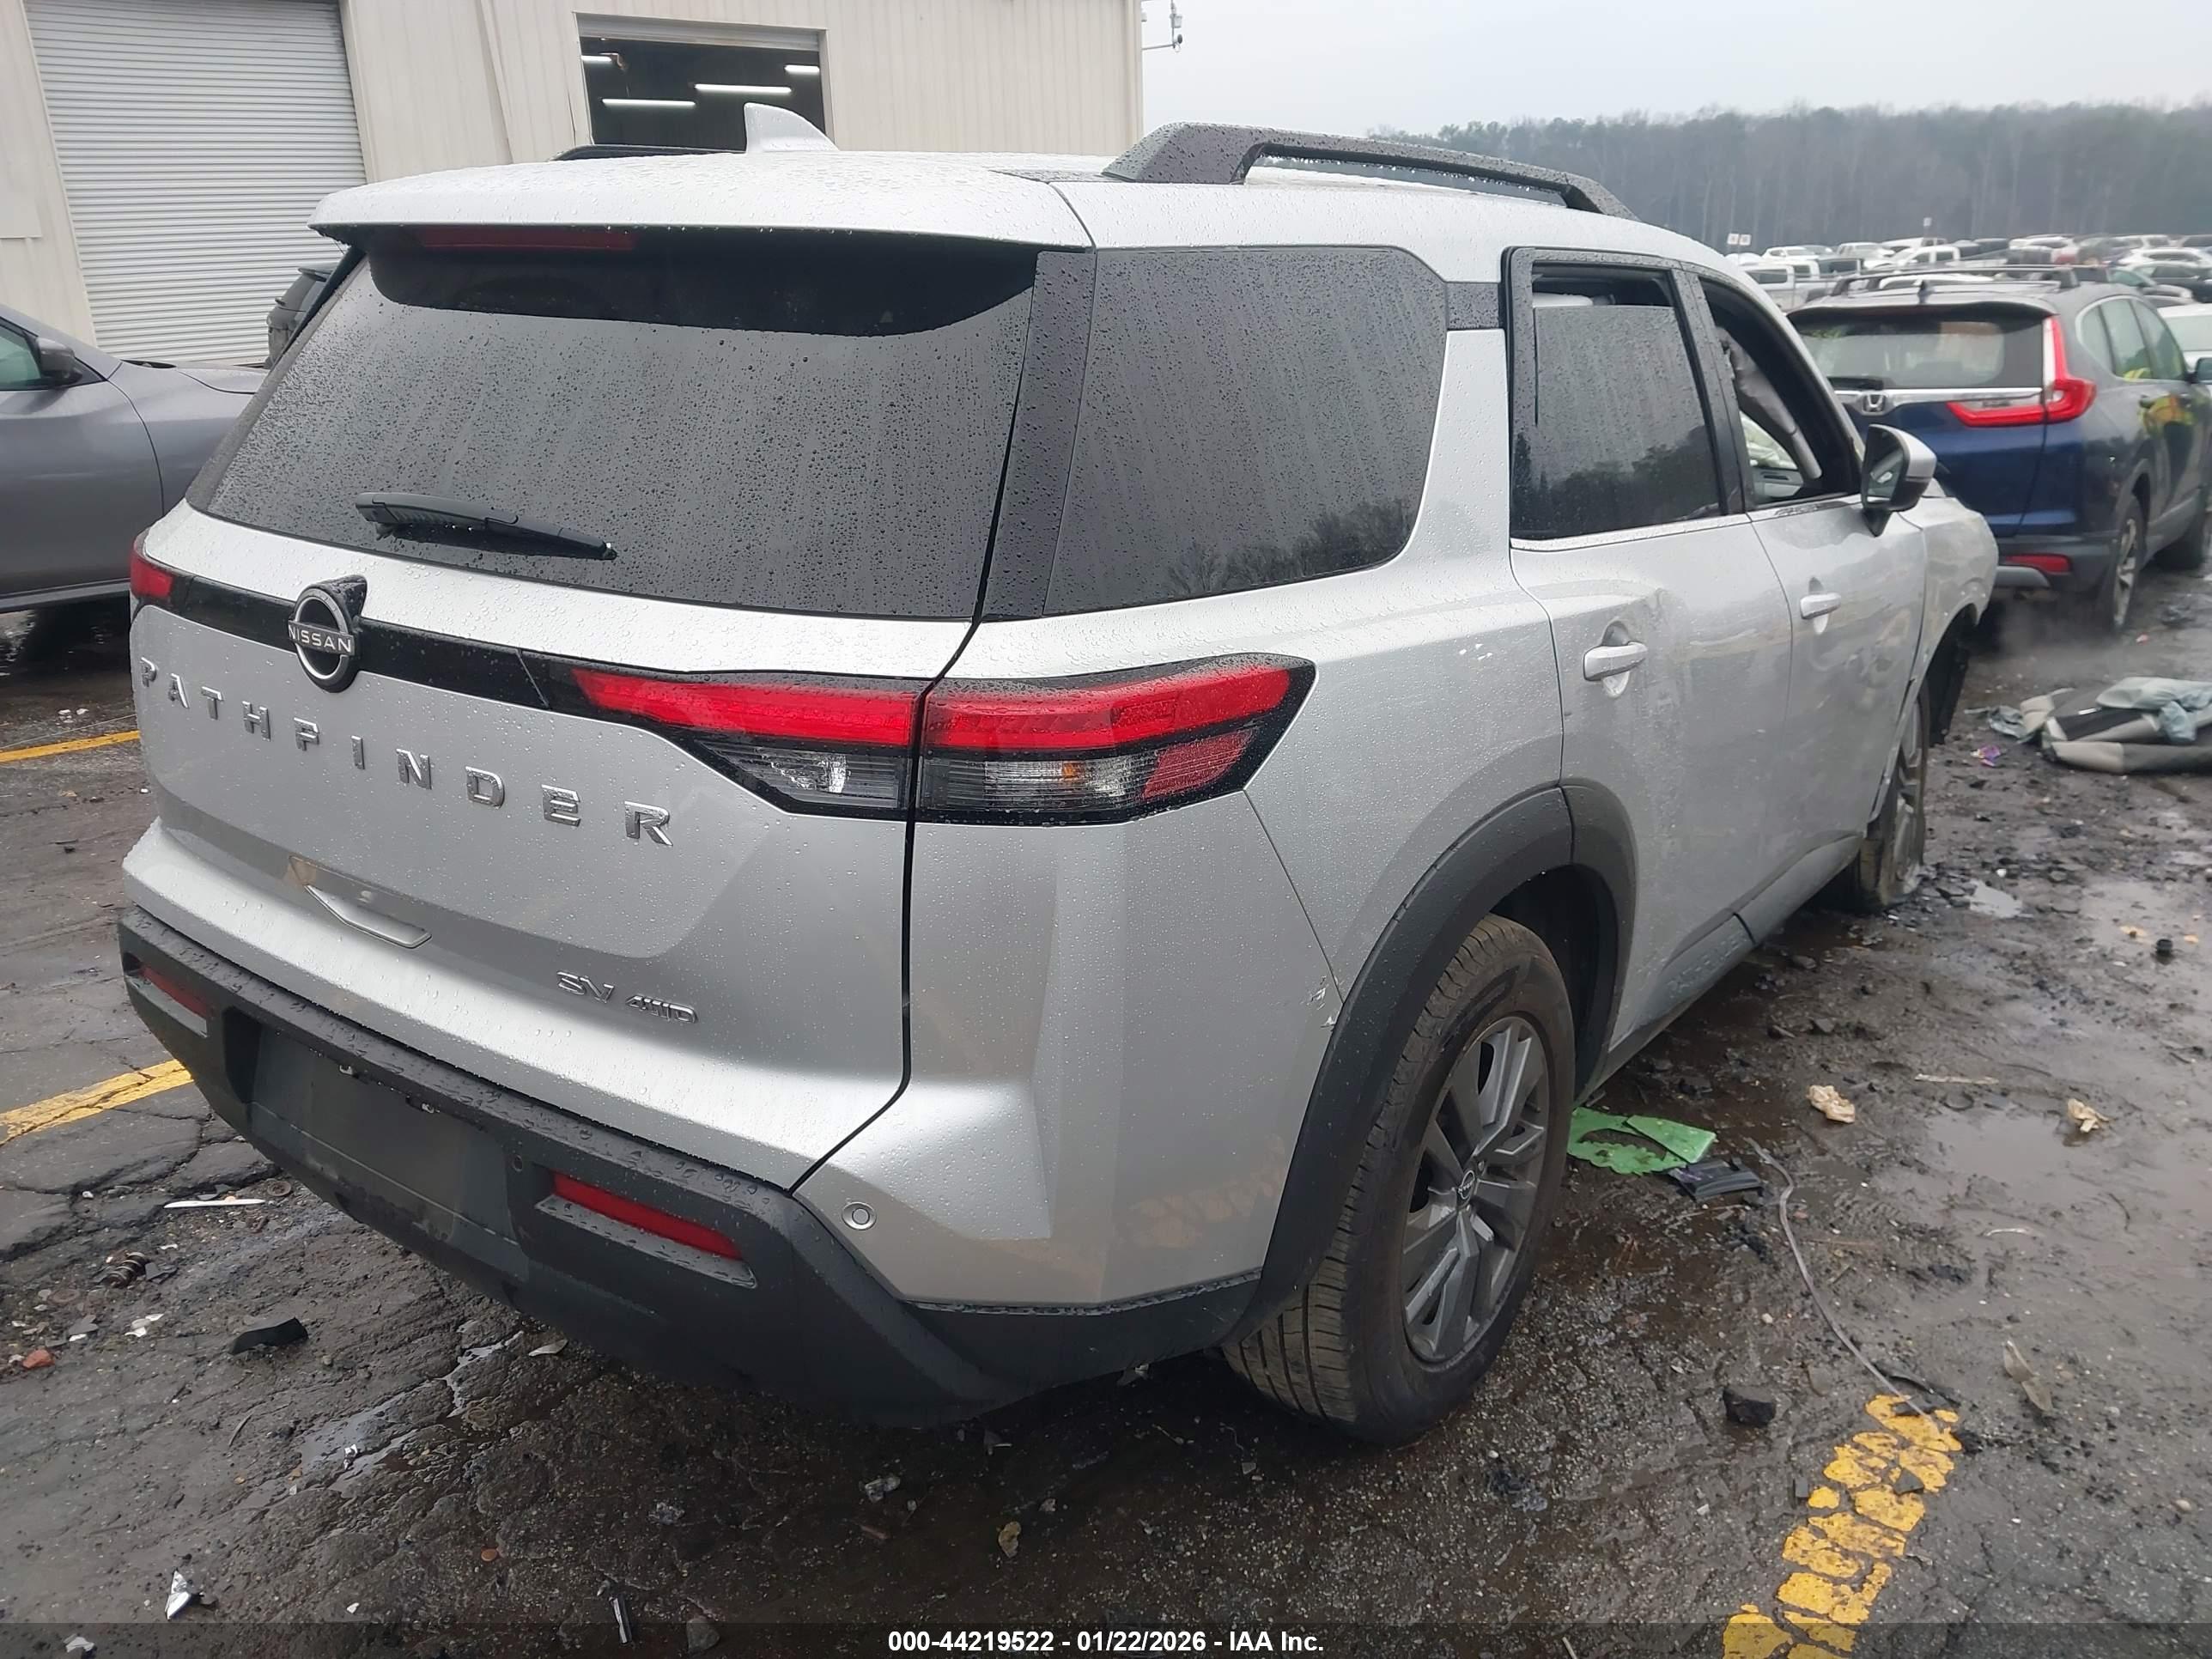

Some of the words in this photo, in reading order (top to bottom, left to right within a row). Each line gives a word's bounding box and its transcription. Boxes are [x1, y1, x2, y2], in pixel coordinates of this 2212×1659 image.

[288, 623, 351, 653] NISSAN
[140, 656, 673, 846] PATHFINDER
[556, 970, 616, 1004] SV
[625, 995, 699, 1024] 4WD
